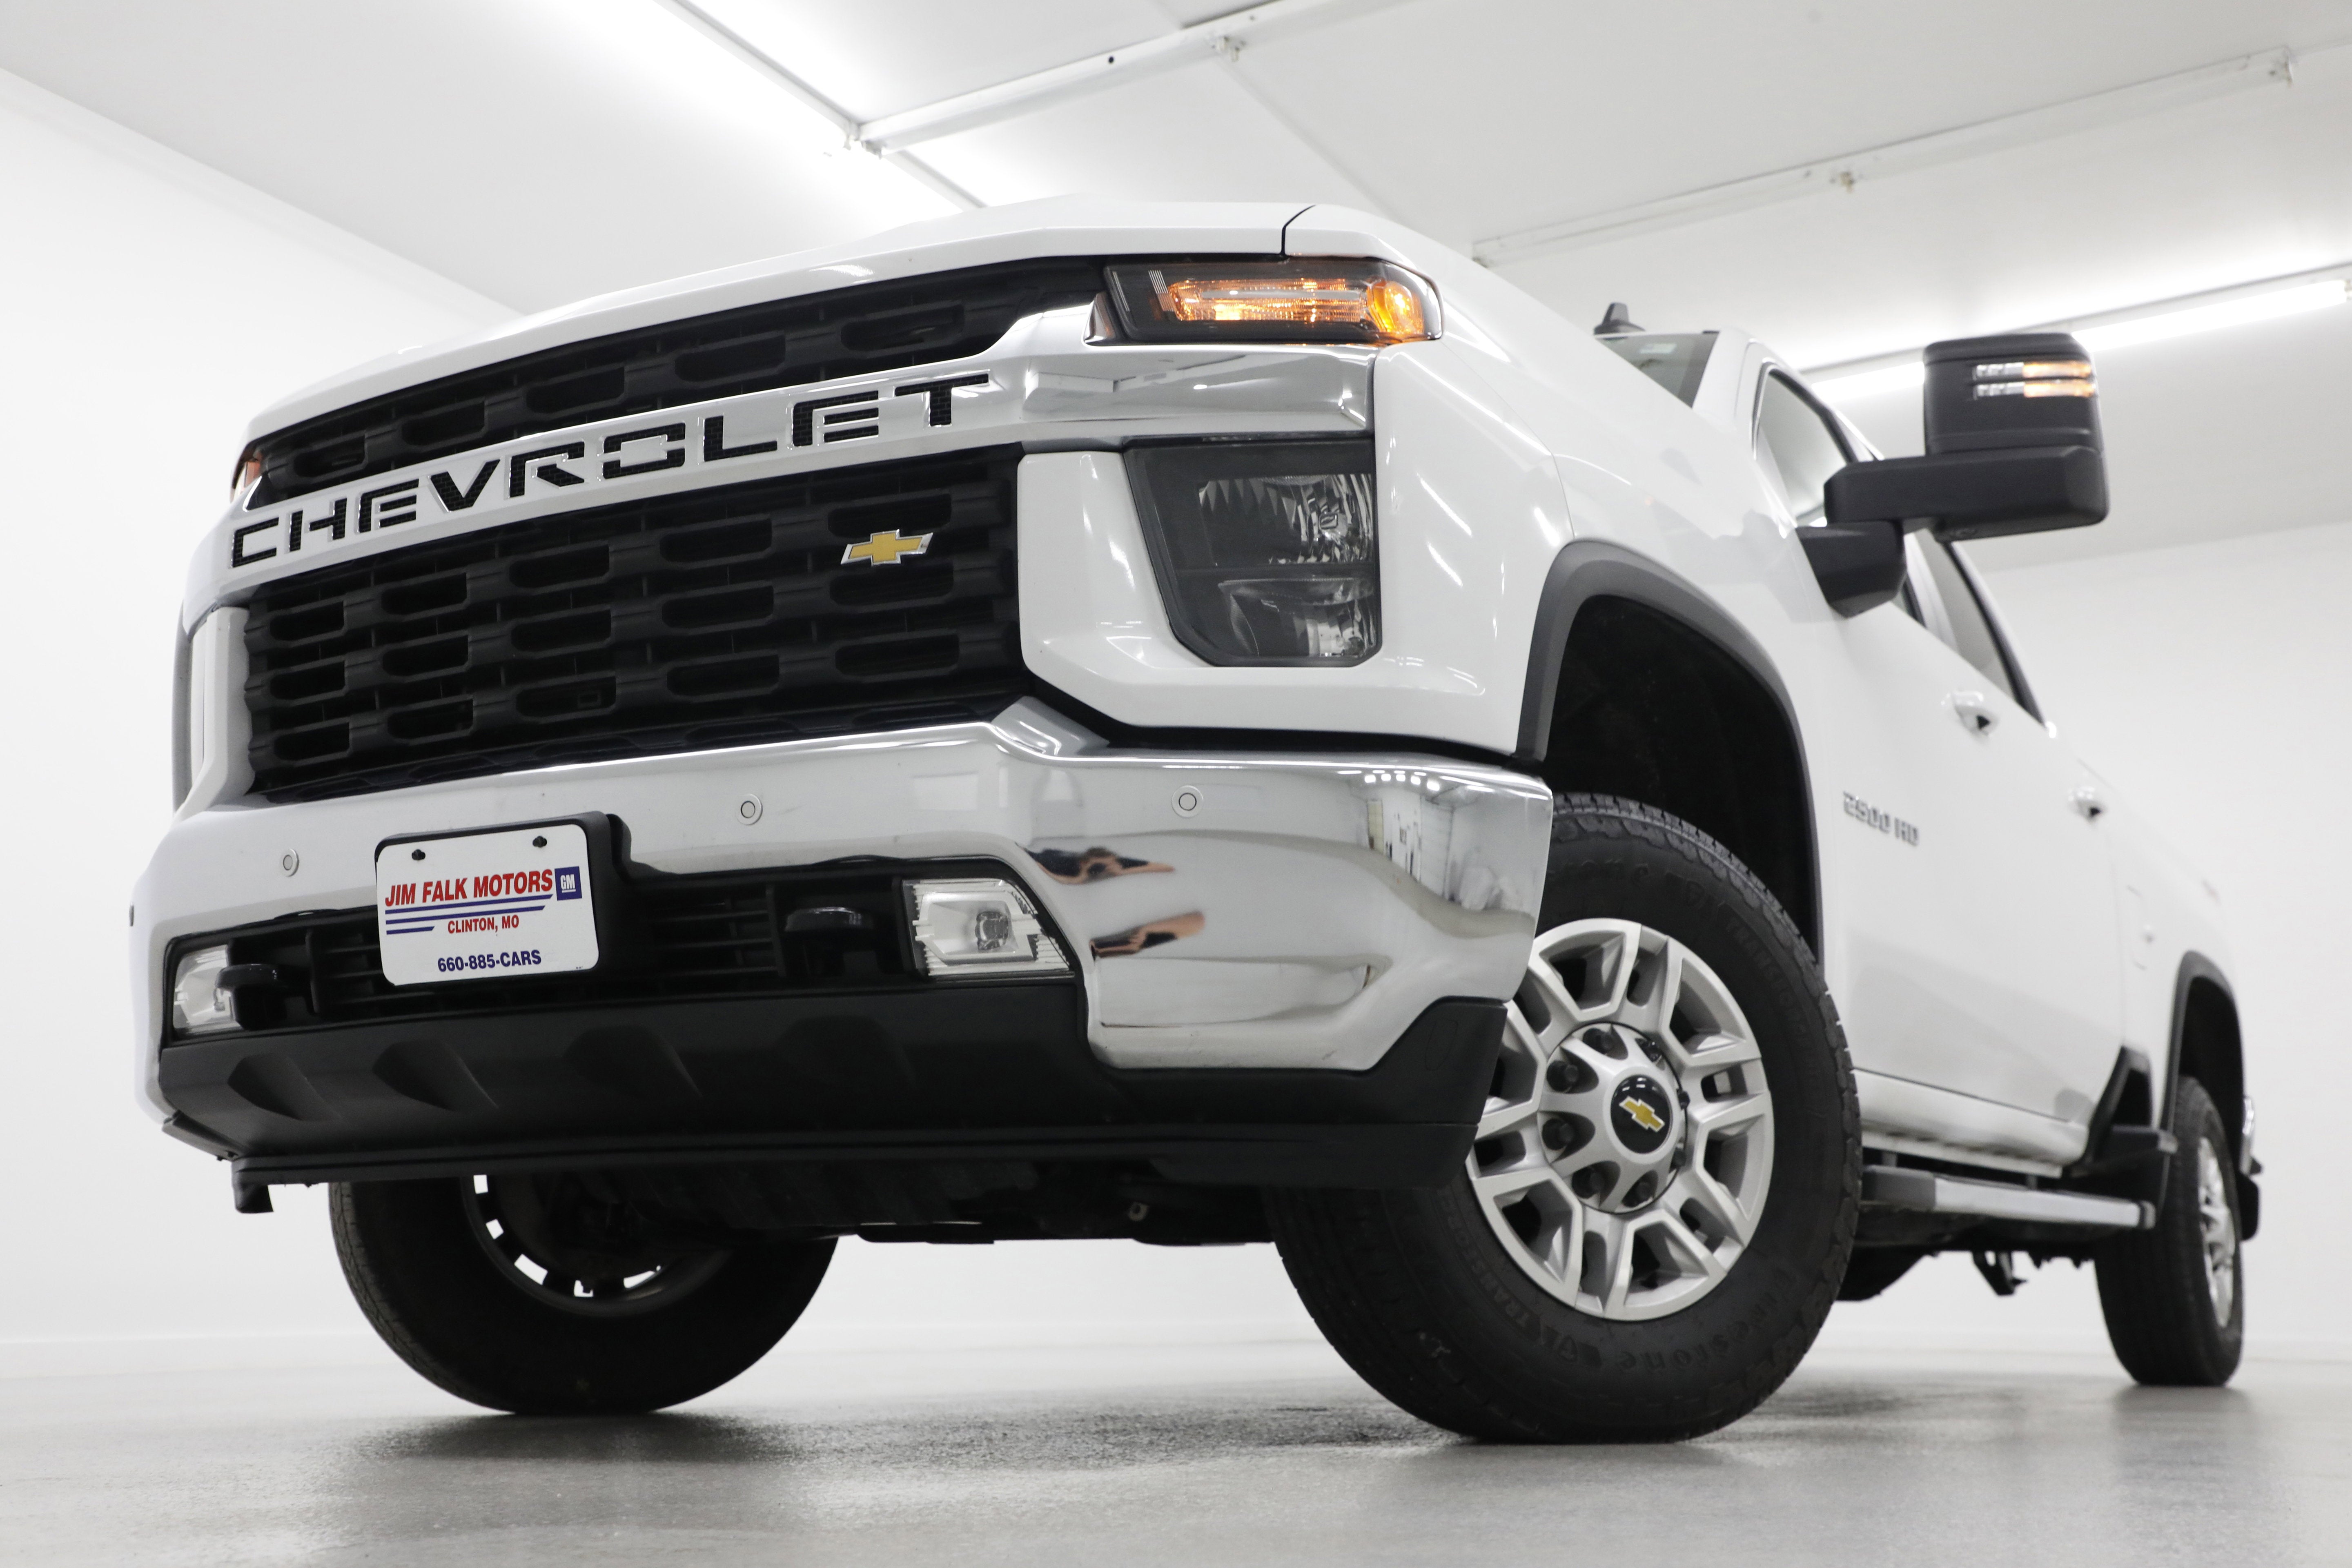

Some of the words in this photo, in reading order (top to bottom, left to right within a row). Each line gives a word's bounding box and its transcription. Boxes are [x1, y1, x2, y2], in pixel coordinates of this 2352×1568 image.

[230, 371, 991, 568] CHEVROLET
[1842, 791, 1890, 834] 2500
[1894, 816, 1919, 847] HD
[385, 883, 416, 906] JIM
[422, 878, 468, 903] FALK
[474, 869, 553, 898] MOTORS
[560, 873, 575, 889] GM
[448, 917, 498, 933] CLINTON,
[502, 915, 519, 929] MO
[437, 950, 542, 972] 660-885-CARS
